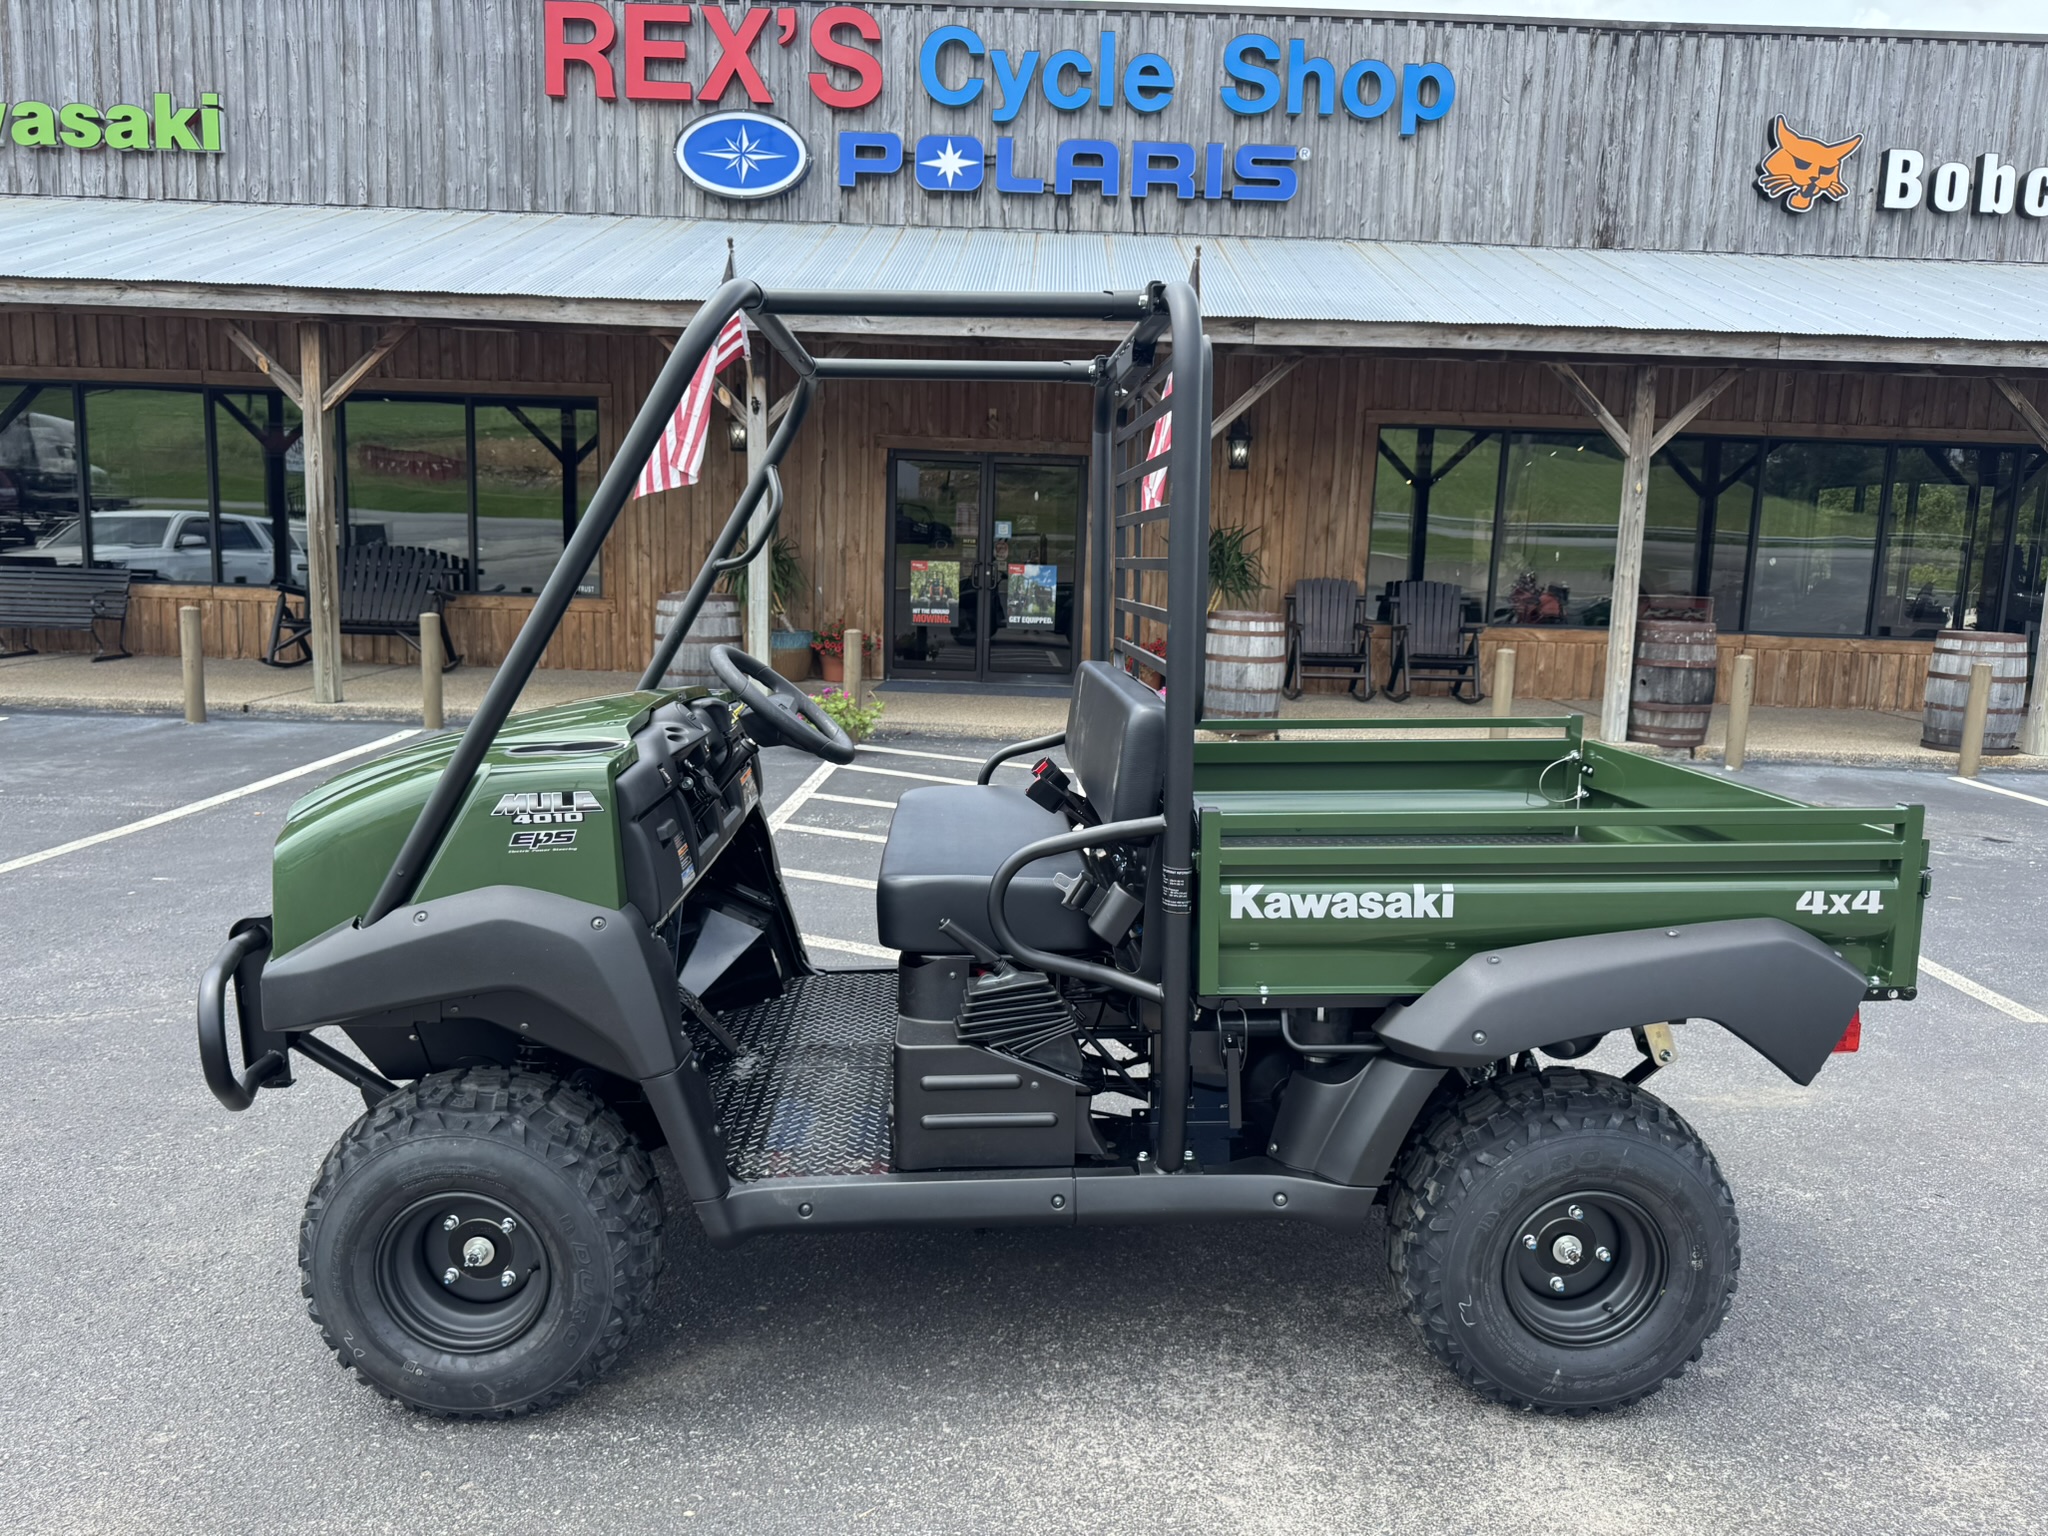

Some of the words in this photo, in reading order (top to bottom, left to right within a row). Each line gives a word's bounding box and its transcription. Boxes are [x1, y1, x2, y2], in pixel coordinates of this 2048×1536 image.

[544, 1, 883, 108] REX'S
[920, 25, 1175, 122] Cycle
[1220, 33, 1455, 136] Shop
[0, 92, 224, 151] asaki
[839, 131, 1298, 200] POLARIS
[912, 614, 951, 624] MOWING.
[1021, 616, 1053, 624] EQUIPPED.
[490, 791, 604, 815] MULE
[513, 813, 583, 824] 4010
[1230, 884, 1454, 919] Kawasaki
[1796, 890, 1884, 915] 4x4
[563, 1241, 595, 1348] DURO
